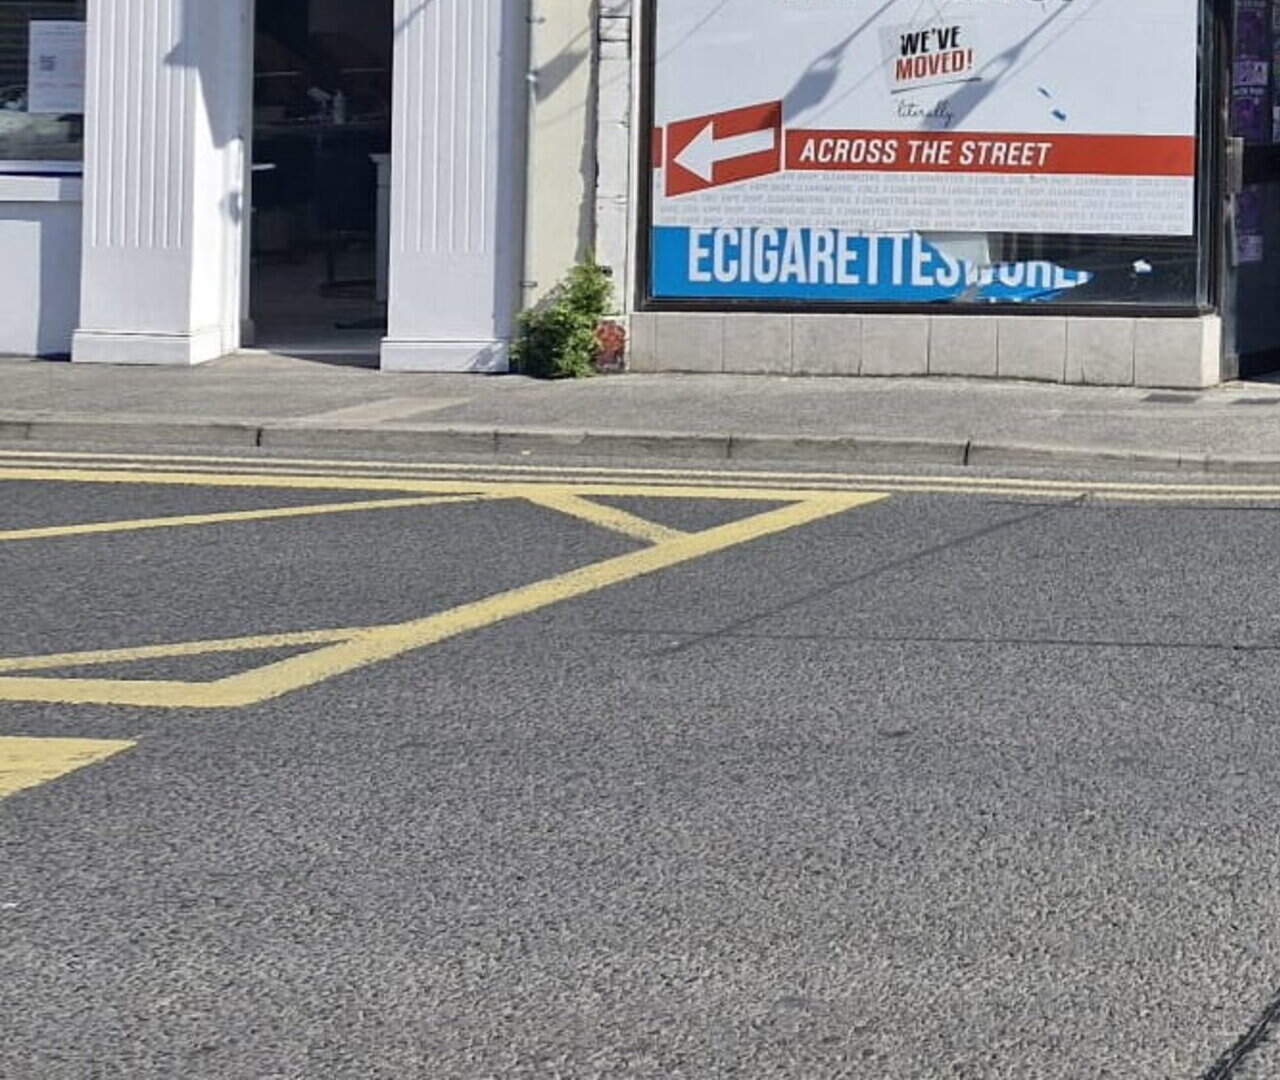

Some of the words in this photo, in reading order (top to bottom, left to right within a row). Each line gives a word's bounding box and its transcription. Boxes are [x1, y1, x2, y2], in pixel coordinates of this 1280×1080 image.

[900, 25, 963, 57] WE'VE
[895, 49, 973, 81] MOVED!
[800, 138, 898, 165] ACROSS
[906, 139, 953, 165] THE
[959, 140, 1052, 167] STREET
[687, 227, 1093, 288] ECIGARETTES
